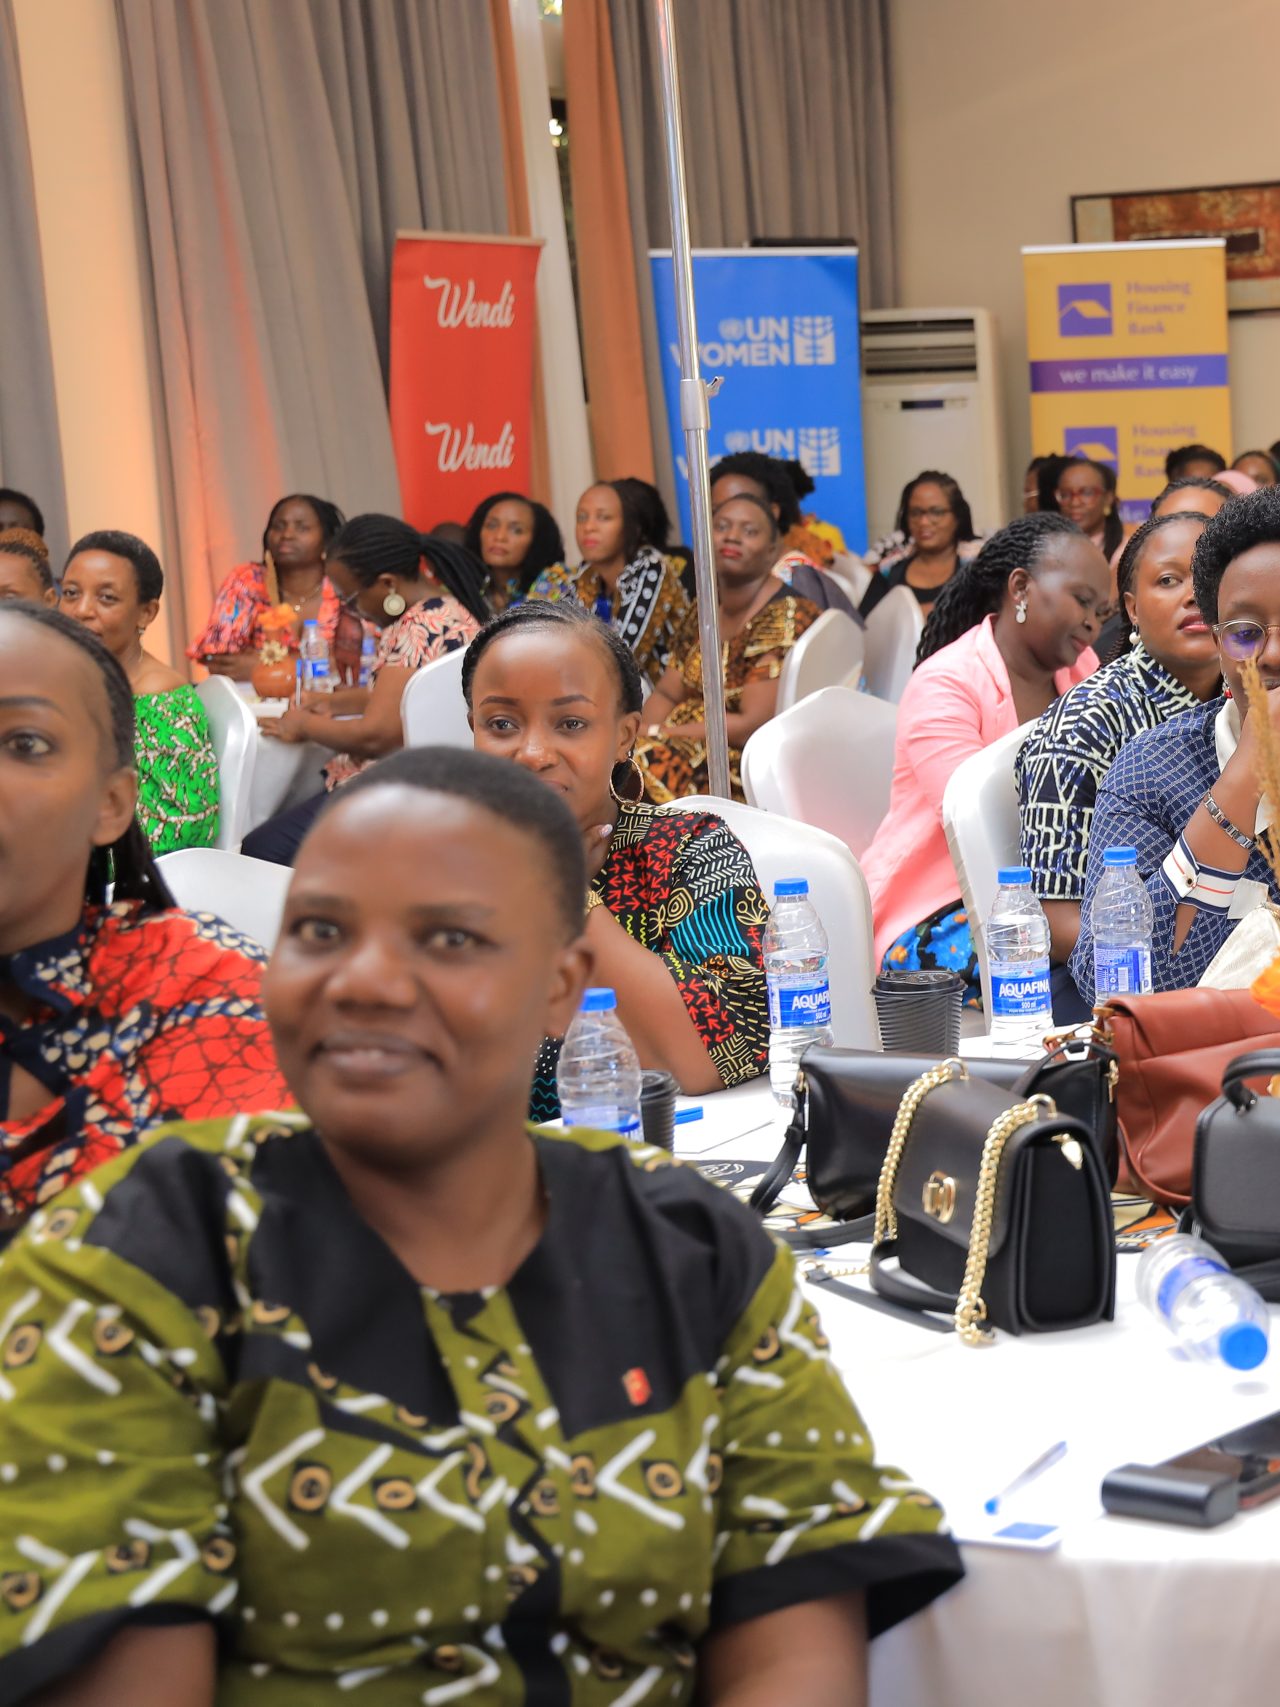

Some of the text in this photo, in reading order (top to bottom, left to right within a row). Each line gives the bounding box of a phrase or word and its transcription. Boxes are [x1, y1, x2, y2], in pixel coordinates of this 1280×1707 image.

[1126, 281, 1192, 297] Housing
[424, 275, 515, 328] Wendi
[1127, 301, 1185, 315] Finance
[746, 316, 789, 342] UN
[1128, 320, 1166, 336] Bank
[1059, 362, 1198, 384] we make it easy
[752, 429, 795, 453] UN
[1132, 424, 1197, 439] Housing
[425, 421, 515, 472] Wendi
[999, 978, 1050, 999] AQUAFINA
